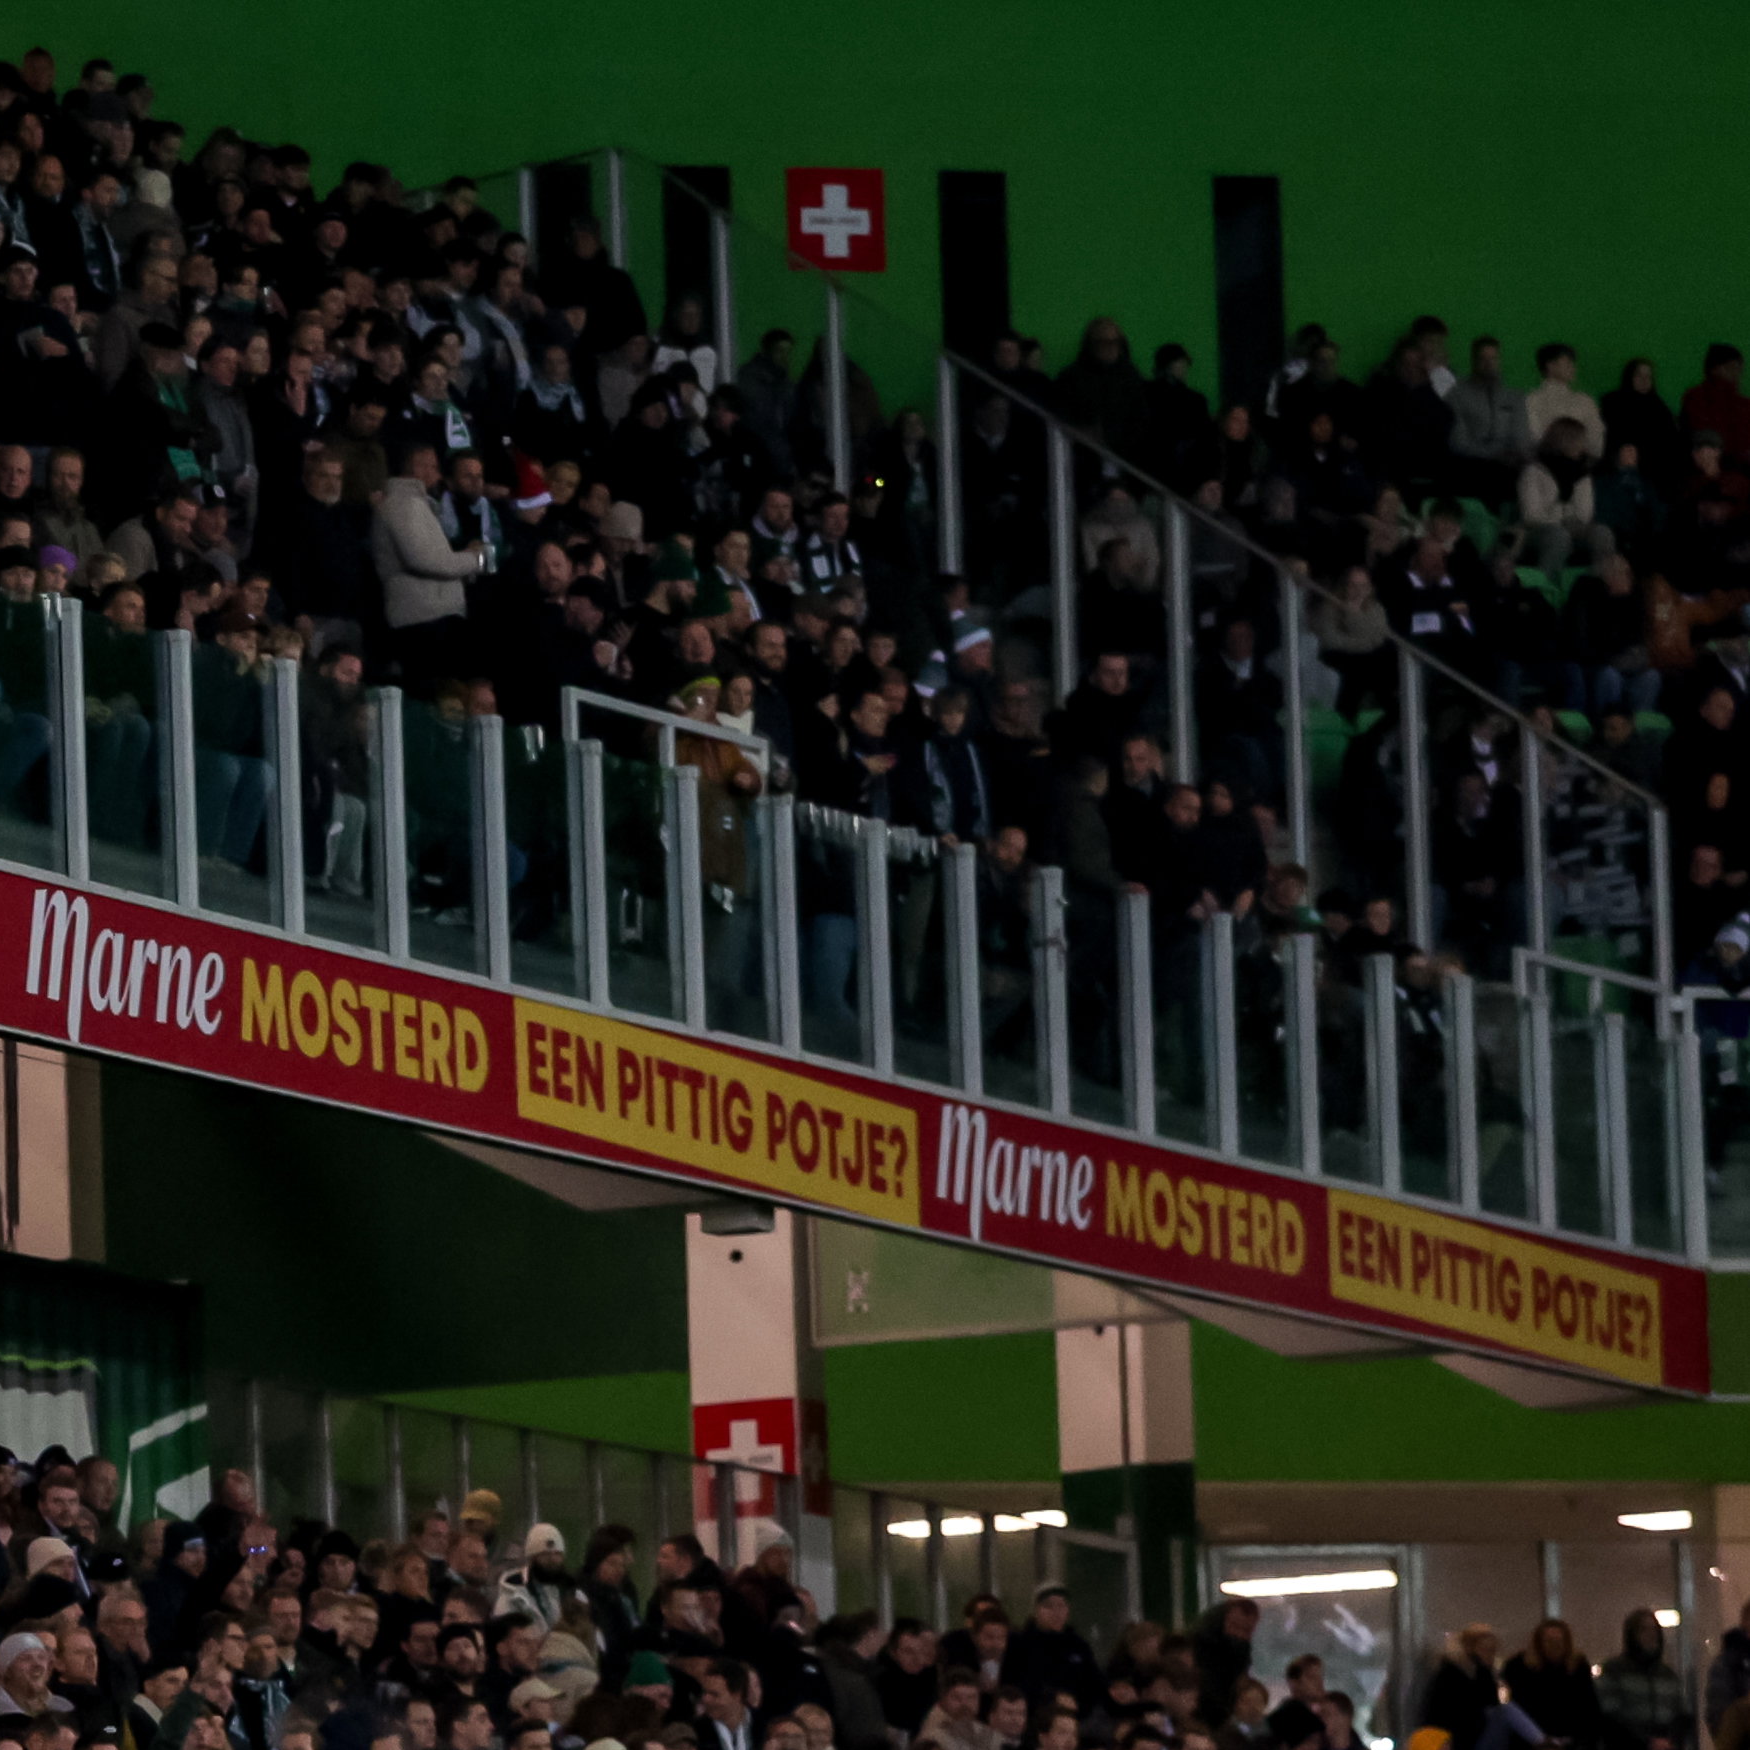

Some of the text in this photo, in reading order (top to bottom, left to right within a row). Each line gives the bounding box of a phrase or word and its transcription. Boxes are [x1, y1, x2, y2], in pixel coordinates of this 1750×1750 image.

[26, 888, 490, 1094] Marne MOSTERD
[527, 1020, 910, 1197] EEN PITTIG POTJE?
[936, 1103, 1306, 1277] Marne MOSTERD
[1337, 1211, 1653, 1360] EEN PITTIG POTJE?
